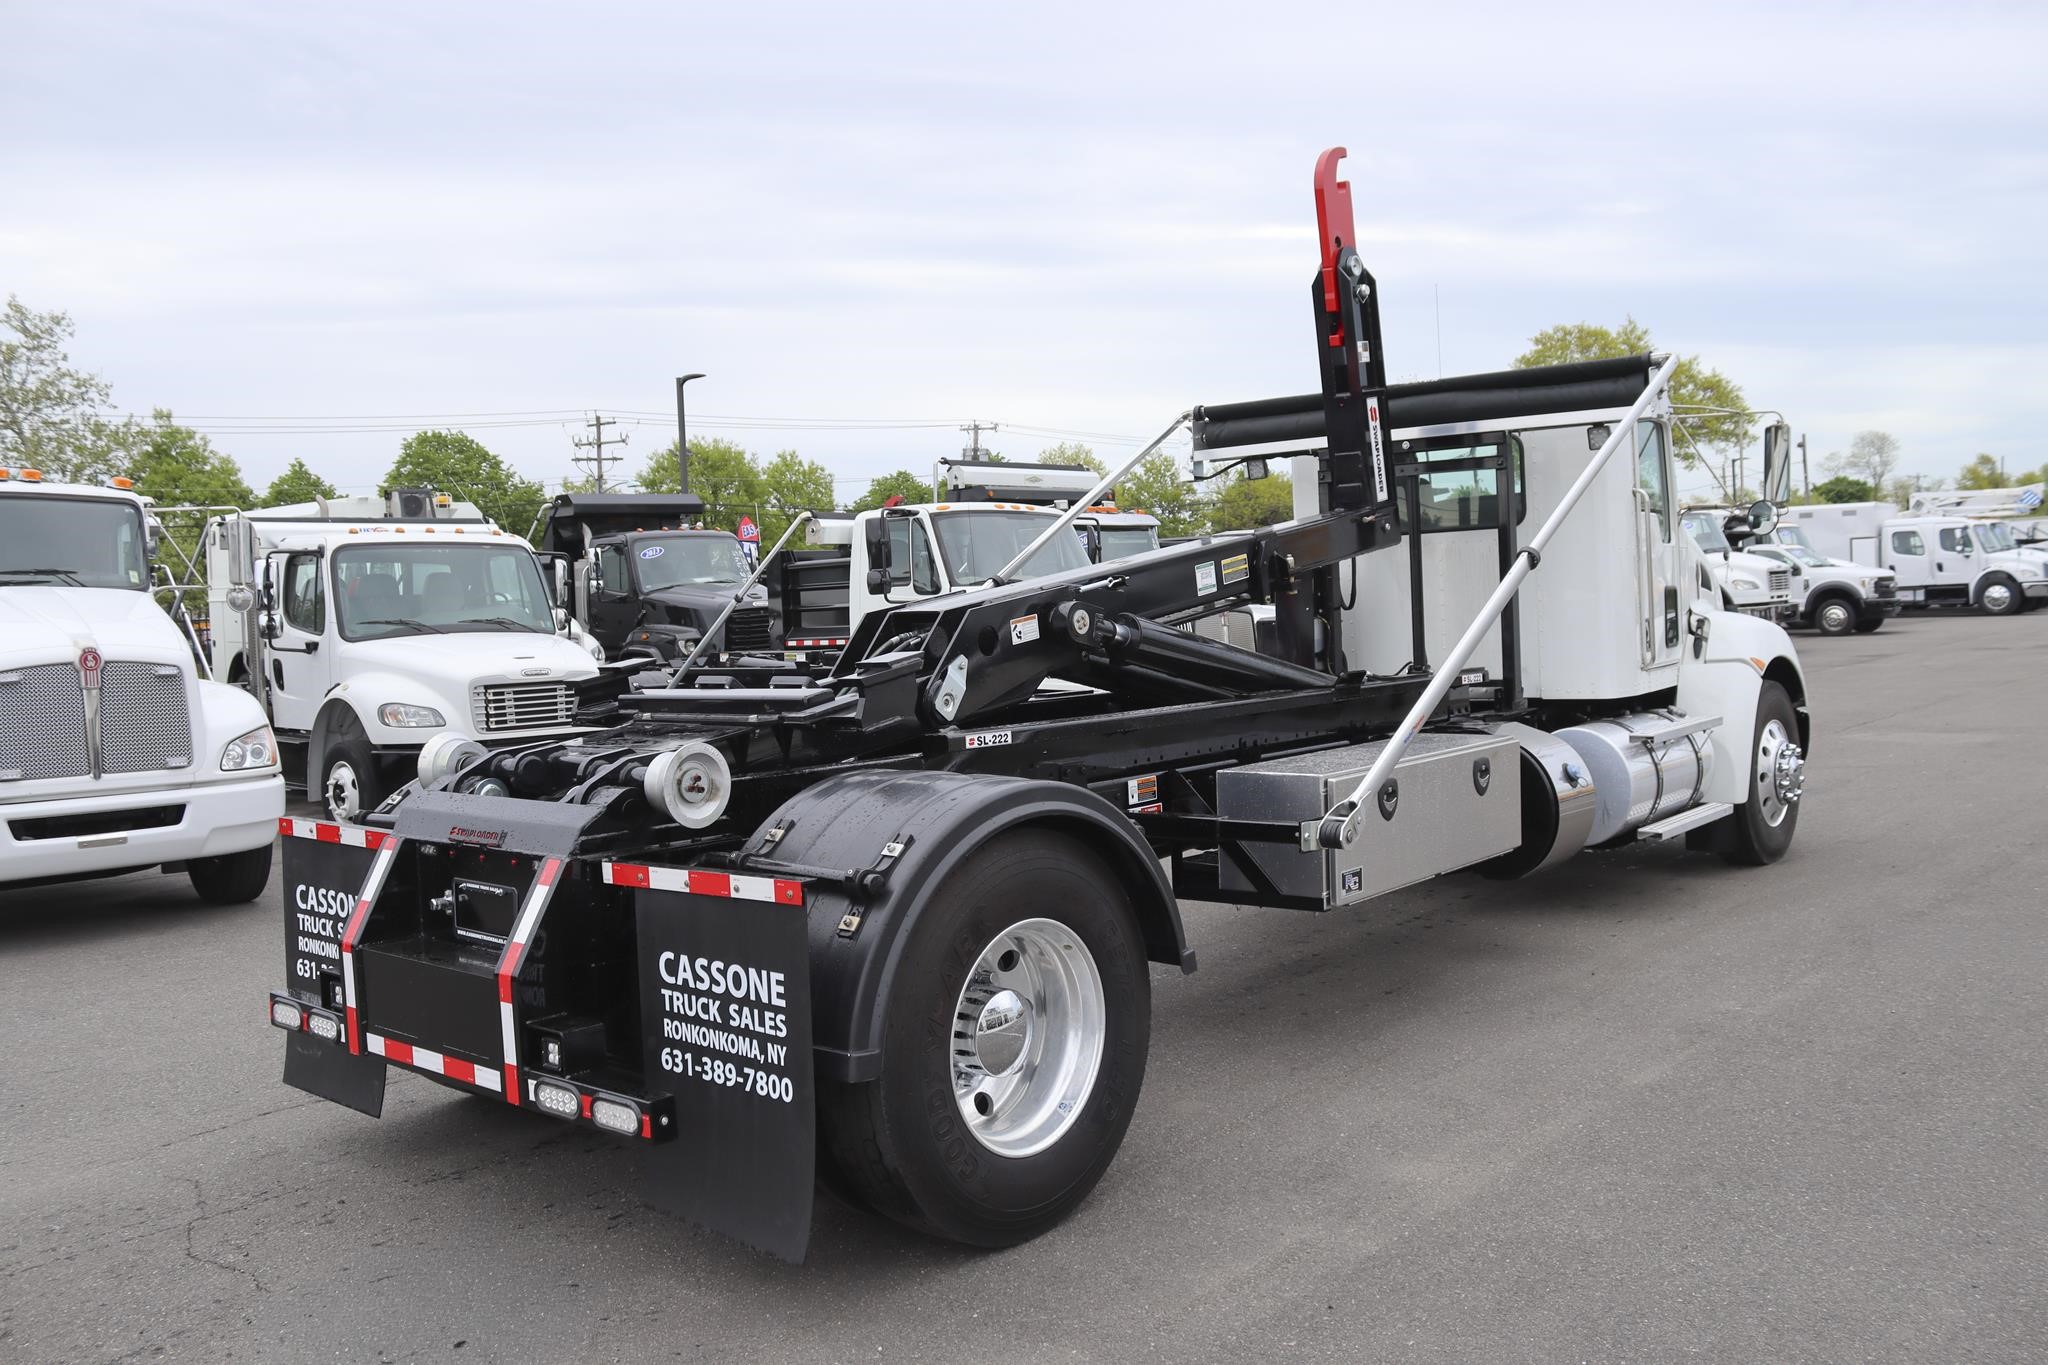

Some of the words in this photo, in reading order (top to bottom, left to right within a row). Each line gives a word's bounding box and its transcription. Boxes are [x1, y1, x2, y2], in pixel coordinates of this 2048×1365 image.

[1372, 424, 1384, 493] SWAPLOADER
[976, 733, 1009, 747] SL-222
[295, 884, 358, 918] CASSON
[296, 913, 334, 938] TRUCK
[658, 950, 787, 1008] CASSONE
[660, 988, 722, 1024] TRUCK
[728, 1003, 788, 1038] SALES
[663, 1017, 765, 1064] RONKONKOMA,
[767, 1042, 787, 1067] NY
[660, 1047, 794, 1103] 631-389-7800
